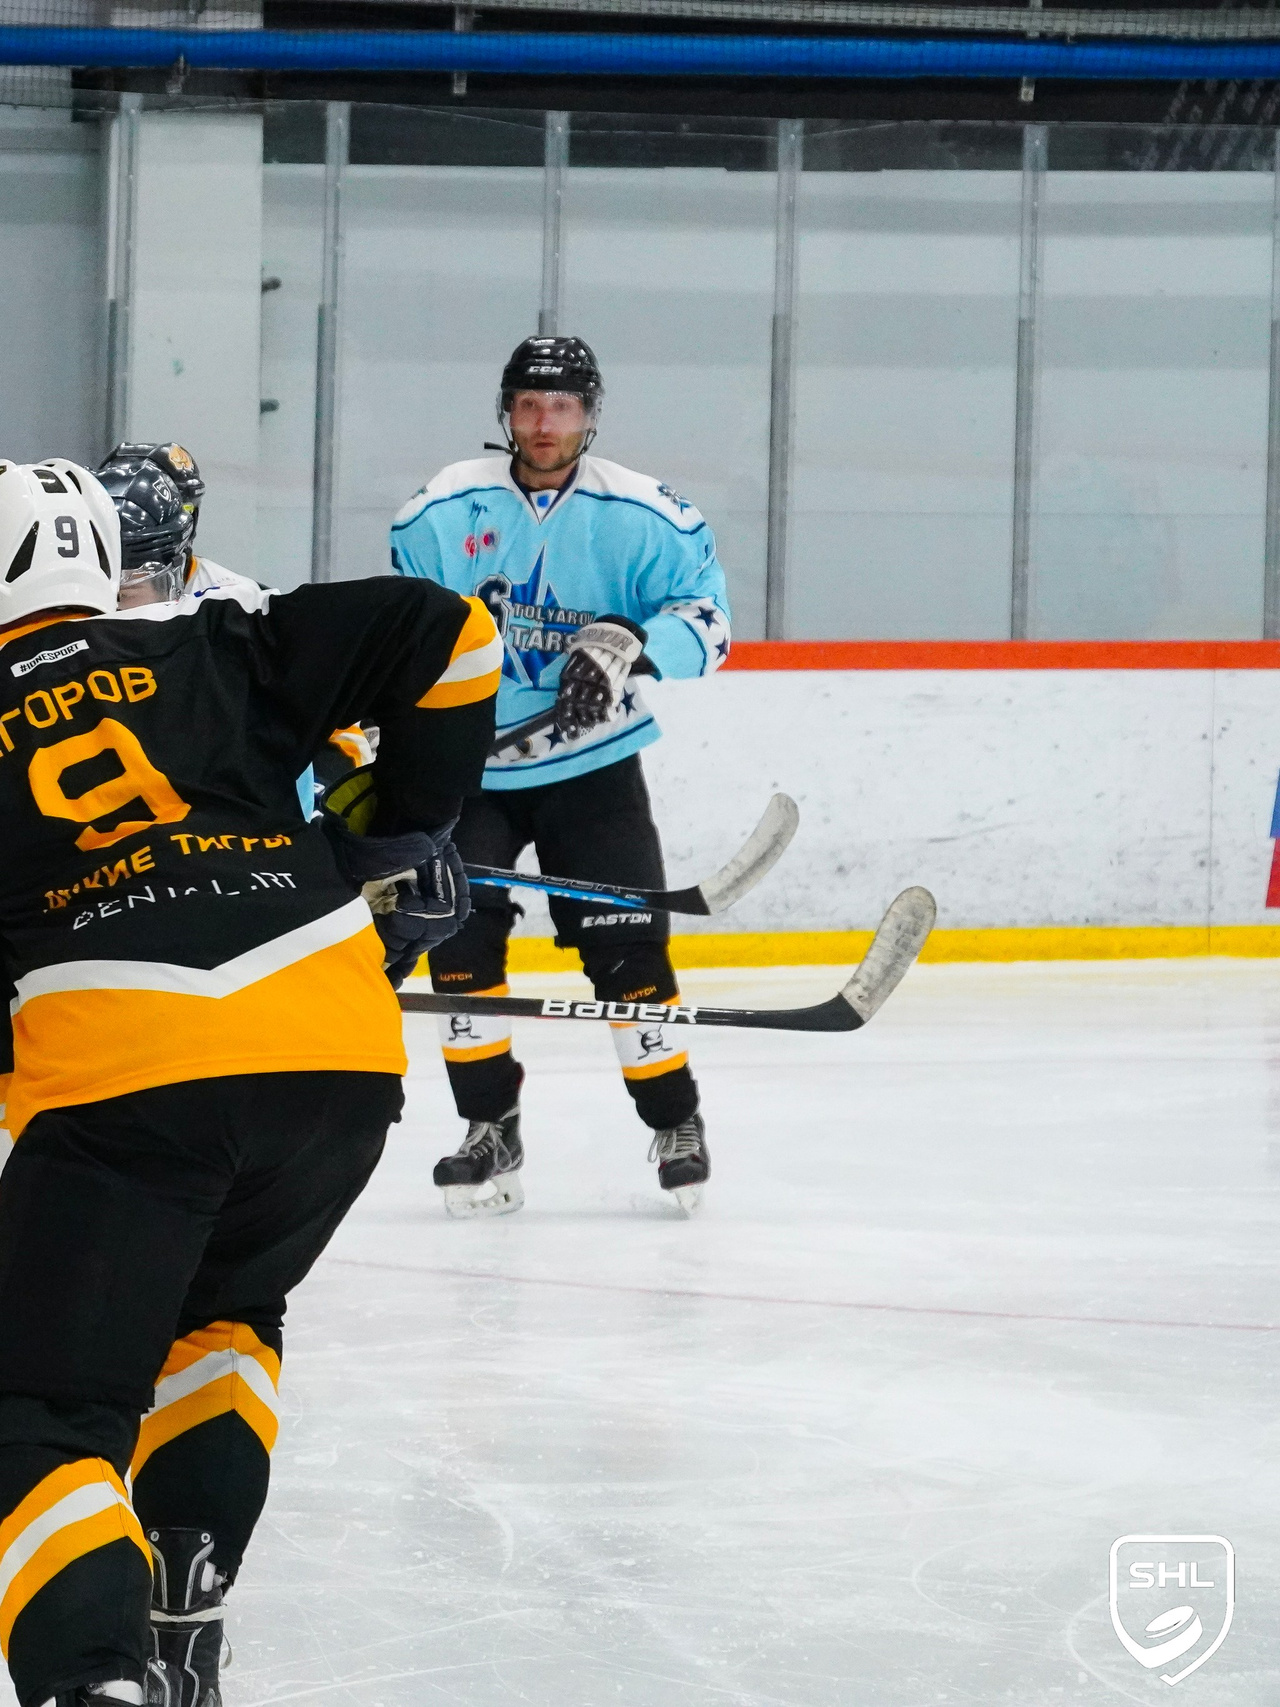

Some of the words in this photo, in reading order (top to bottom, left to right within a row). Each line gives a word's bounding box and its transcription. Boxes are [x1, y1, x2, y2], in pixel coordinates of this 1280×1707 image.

[528, 365, 564, 375] CCM
[54, 515, 80, 559] 9
[27, 717, 192, 852] 9
[581, 912, 652, 928] EASTON
[541, 999, 699, 1024] BAUER
